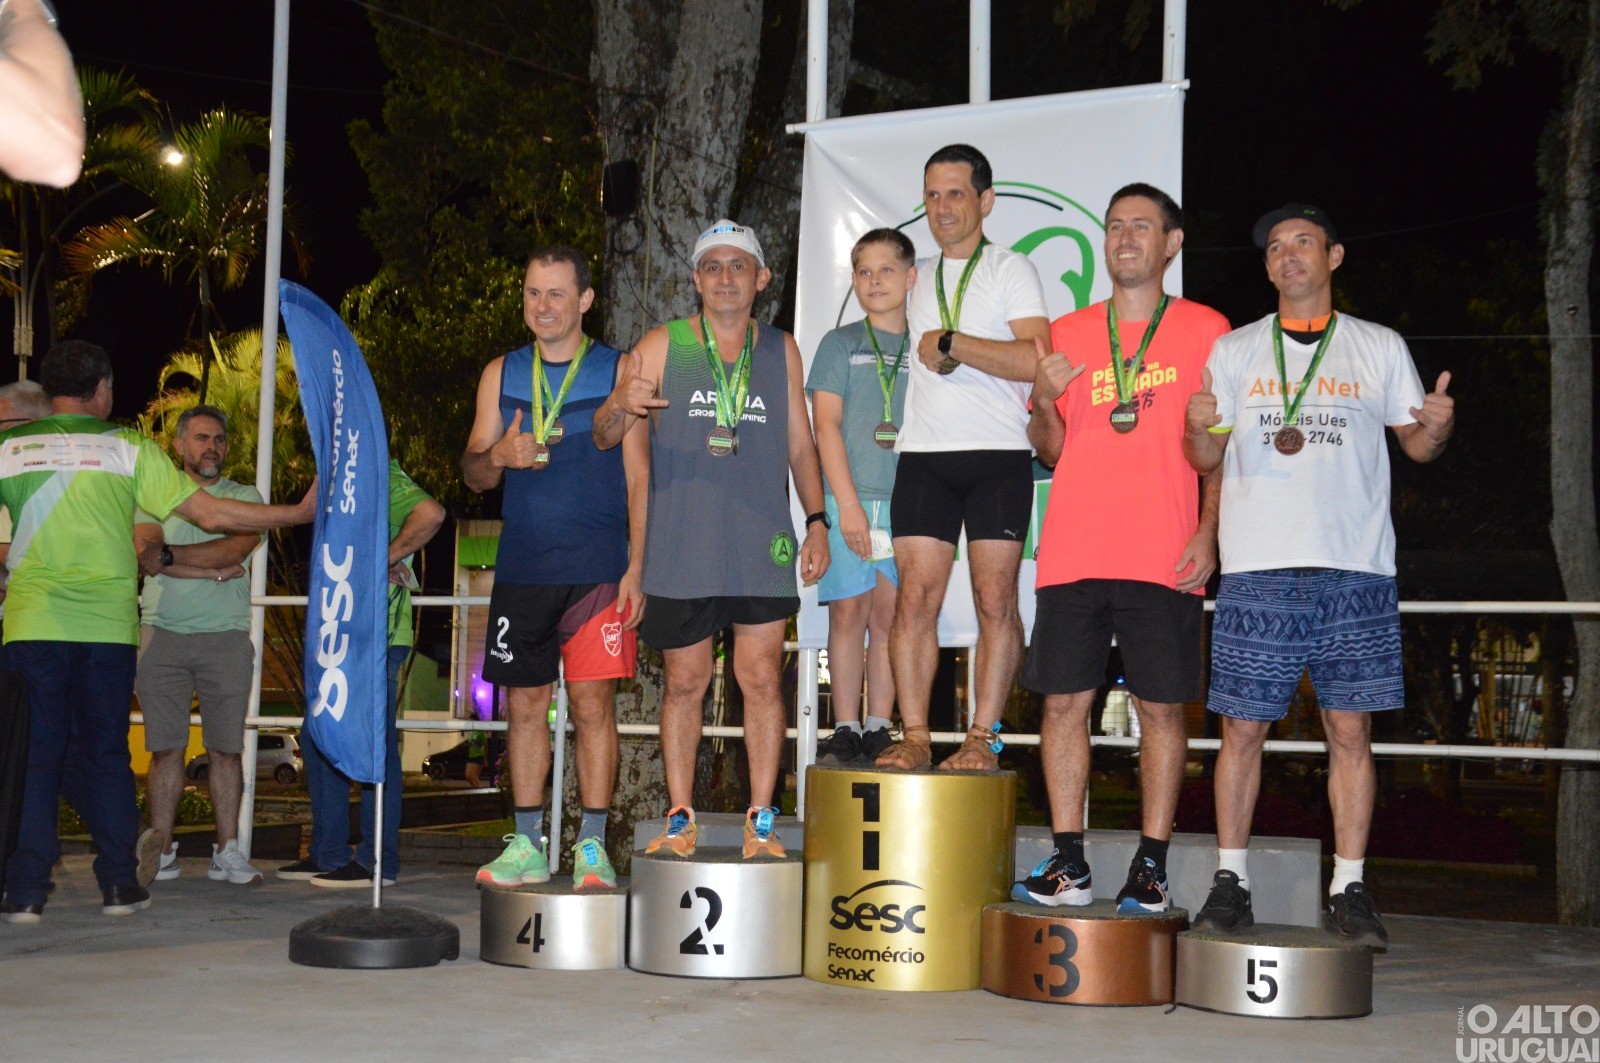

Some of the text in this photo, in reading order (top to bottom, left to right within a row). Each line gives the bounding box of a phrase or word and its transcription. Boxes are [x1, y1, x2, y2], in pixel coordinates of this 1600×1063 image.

[1091, 366, 1177, 406] ESADA
[1092, 362, 1160, 387] PÉ NA
[1317, 377, 1361, 400] Net
[688, 409, 717, 418] CROS
[689, 390, 766, 410] ARA
[1260, 411, 1348, 428] Móis Ues
[1263, 431, 1343, 446] 3-2746
[340, 428, 360, 515] Senac
[312, 543, 354, 722] Sesc
[496, 616, 510, 649] 2
[606, 633, 620, 642] SMT
[852, 782, 880, 870] 1
[679, 886, 725, 956] 2
[829, 893, 926, 934] Sesc
[516, 912, 545, 953] 4
[827, 942, 925, 964] Fecomércio
[1033, 923, 1081, 998] 3
[827, 964, 876, 983] Senac
[1246, 958, 1278, 1004] 5
